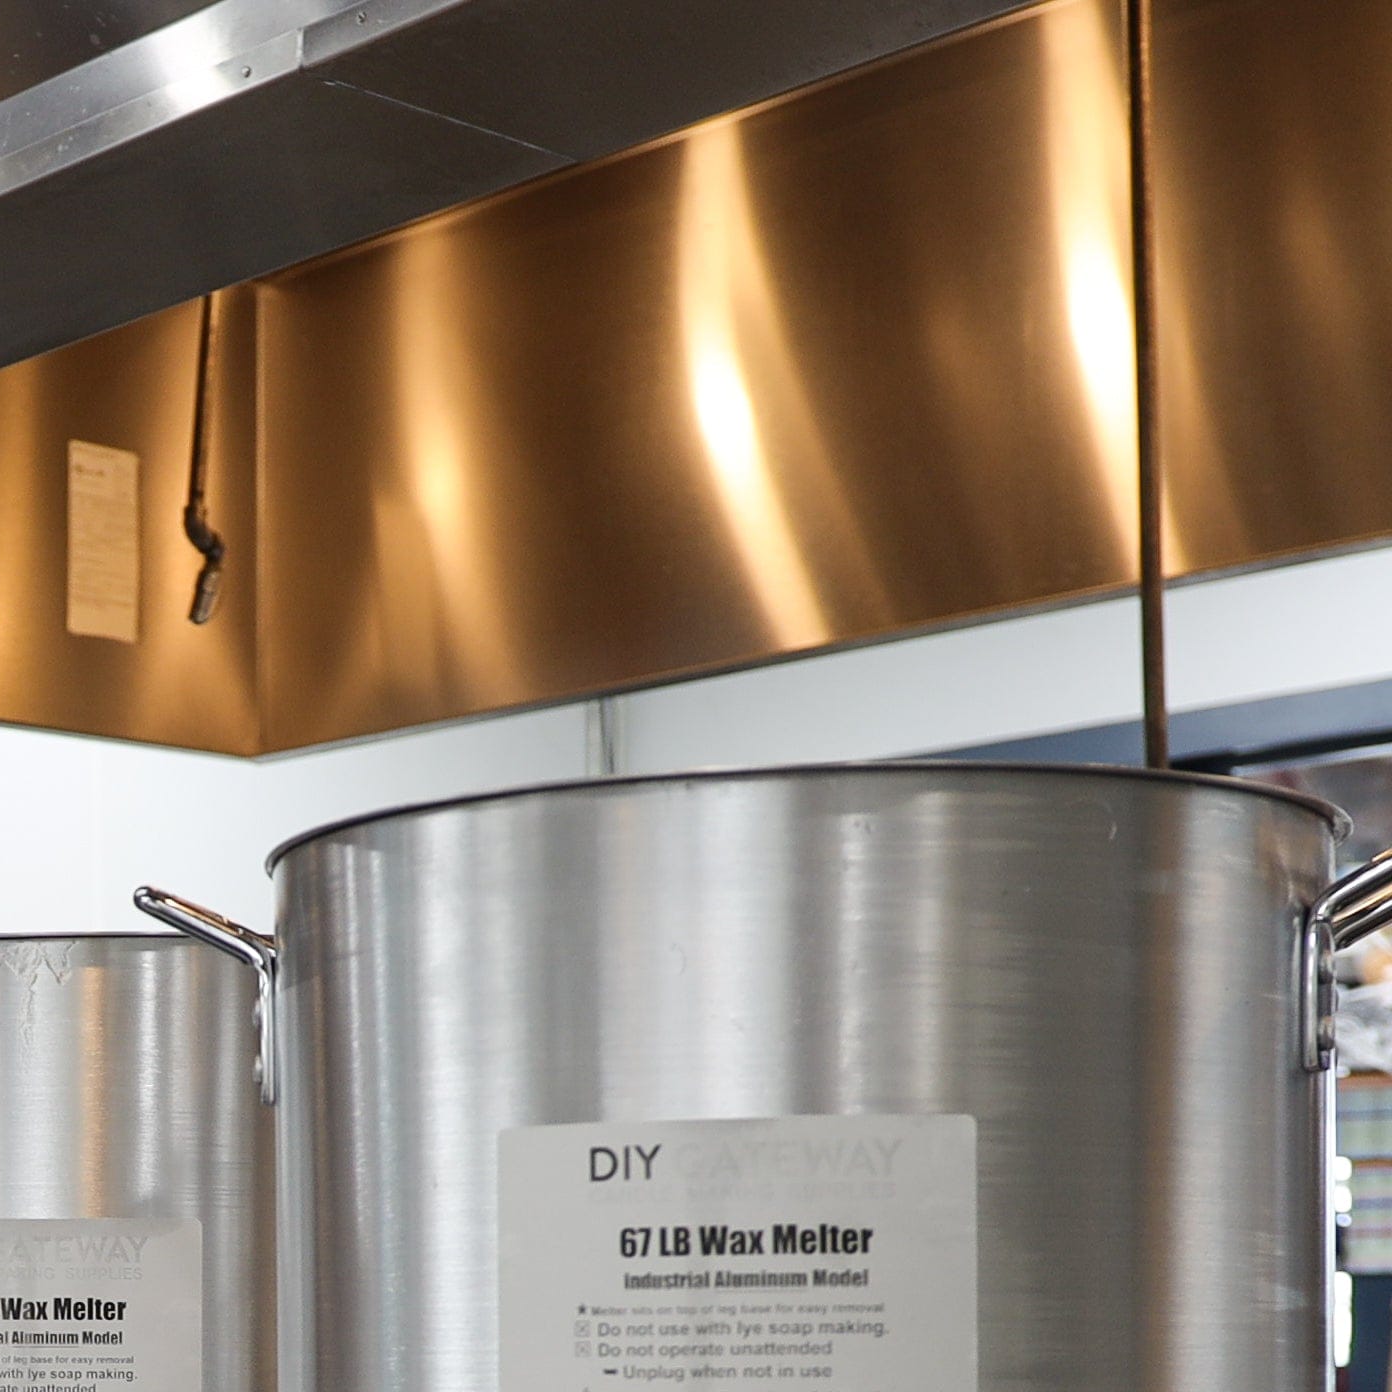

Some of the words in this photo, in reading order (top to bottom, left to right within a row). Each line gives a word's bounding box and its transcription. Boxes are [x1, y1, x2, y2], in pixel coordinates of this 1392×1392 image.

[589, 1144, 662, 1182] DIY
[619, 1227, 651, 1258] 67
[659, 1226, 691, 1256] LB
[698, 1224, 764, 1256] Wax
[772, 1222, 873, 1255] Melter
[623, 1271, 710, 1290] Industrial
[714, 1269, 808, 1288] Aluminum
[812, 1268, 869, 1287] Model
[0, 1297, 48, 1320] Wax
[53, 1297, 127, 1320] Melter
[11, 1330, 79, 1344] Aluminum
[81, 1330, 123, 1344] Model
[596, 1321, 622, 1337] Do
[625, 1323, 654, 1336] not
[657, 1324, 690, 1336] use
[694, 1322, 732, 1335] with
[736, 1321, 763, 1338] lye
[767, 1322, 814, 1337] soap
[596, 1341, 622, 1357] Do
[625, 1343, 654, 1357] not
[657, 1343, 724, 1358] operate
[728, 1341, 833, 1356] unattended
[27, 1368, 46, 1381] lye
[49, 1370, 82, 1380] soap
[85, 1369, 137, 1382] making.
[622, 1365, 685, 1382] Unplug
[689, 1364, 737, 1378] when
[742, 1365, 773, 1378] not
[776, 1366, 795, 1377] in
[799, 1366, 833, 1378] use
